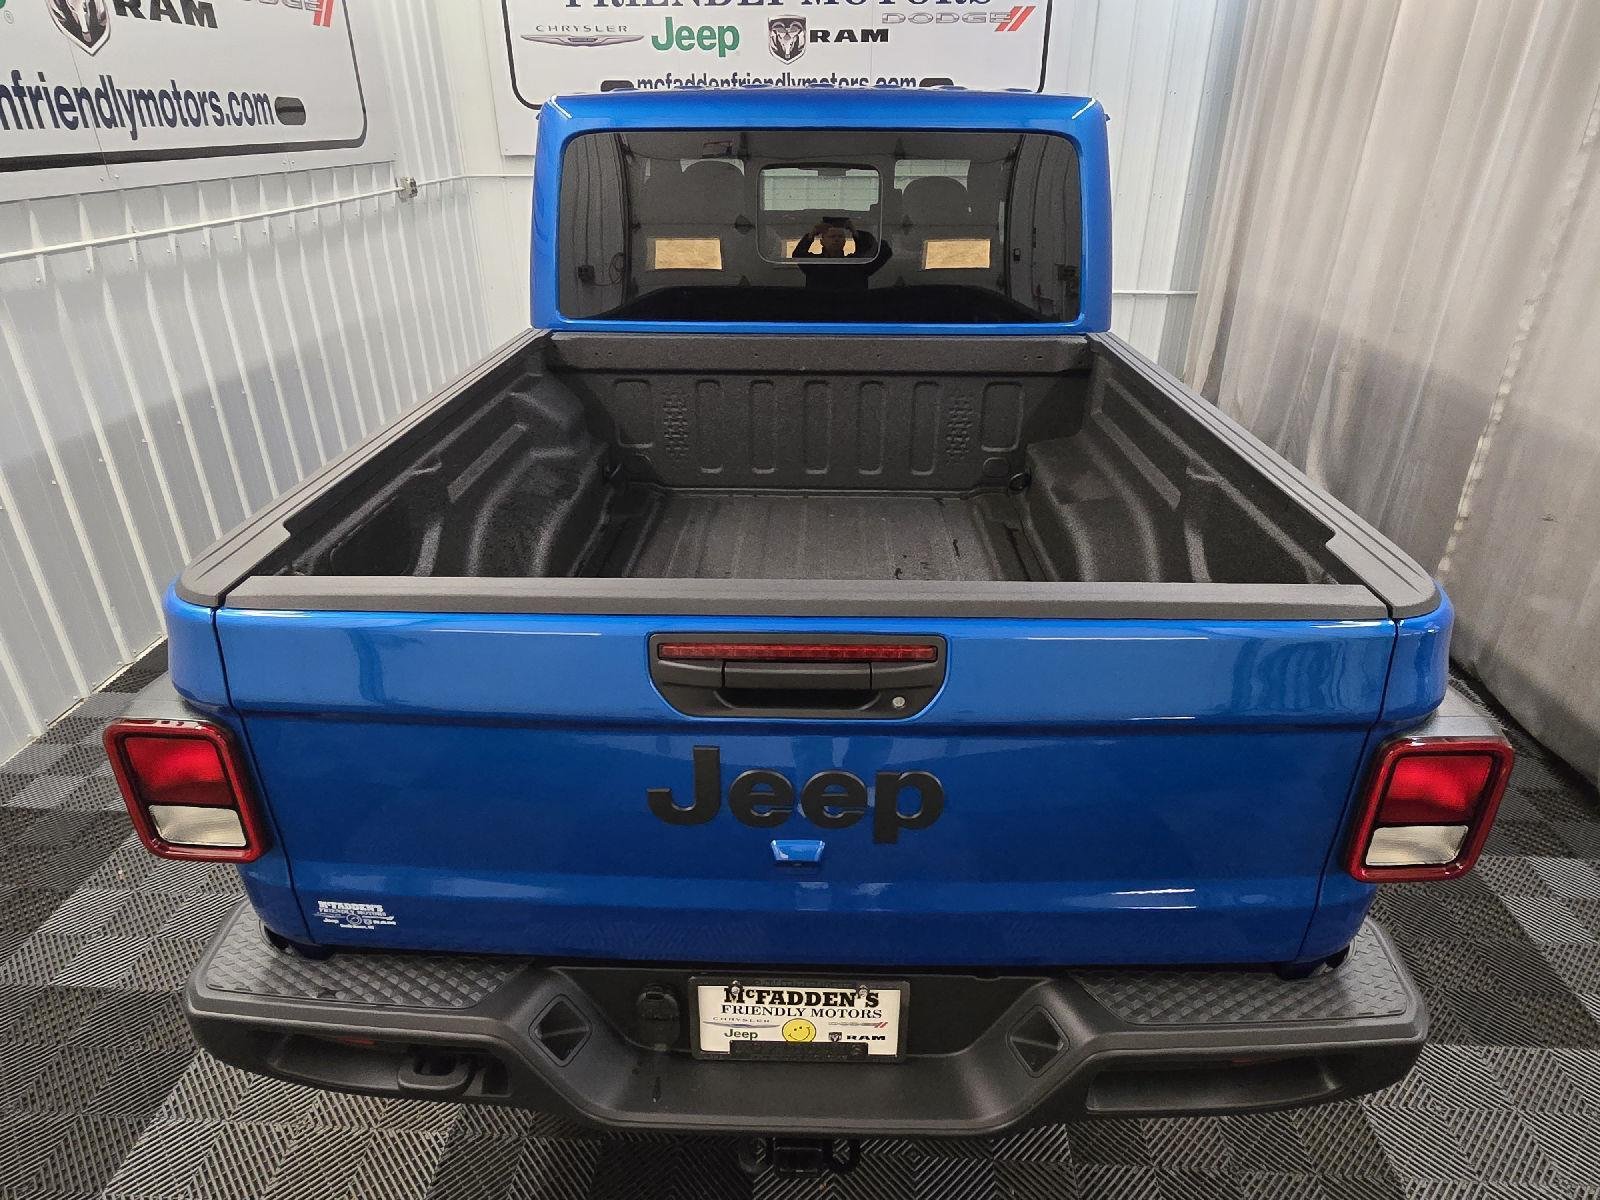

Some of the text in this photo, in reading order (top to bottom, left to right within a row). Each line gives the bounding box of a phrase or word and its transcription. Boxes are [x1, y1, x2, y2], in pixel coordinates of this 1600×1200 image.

[881, 12, 1012, 25] DODGE
[535, 24, 629, 33] CHRYSLER
[809, 28, 889, 43] RAM
[651, 16, 740, 58] Jeep
[646, 744, 945, 845] Jeep
[721, 1004, 882, 1019] FRIENDLY MOTORS
[723, 1028, 759, 1041] Jeep
